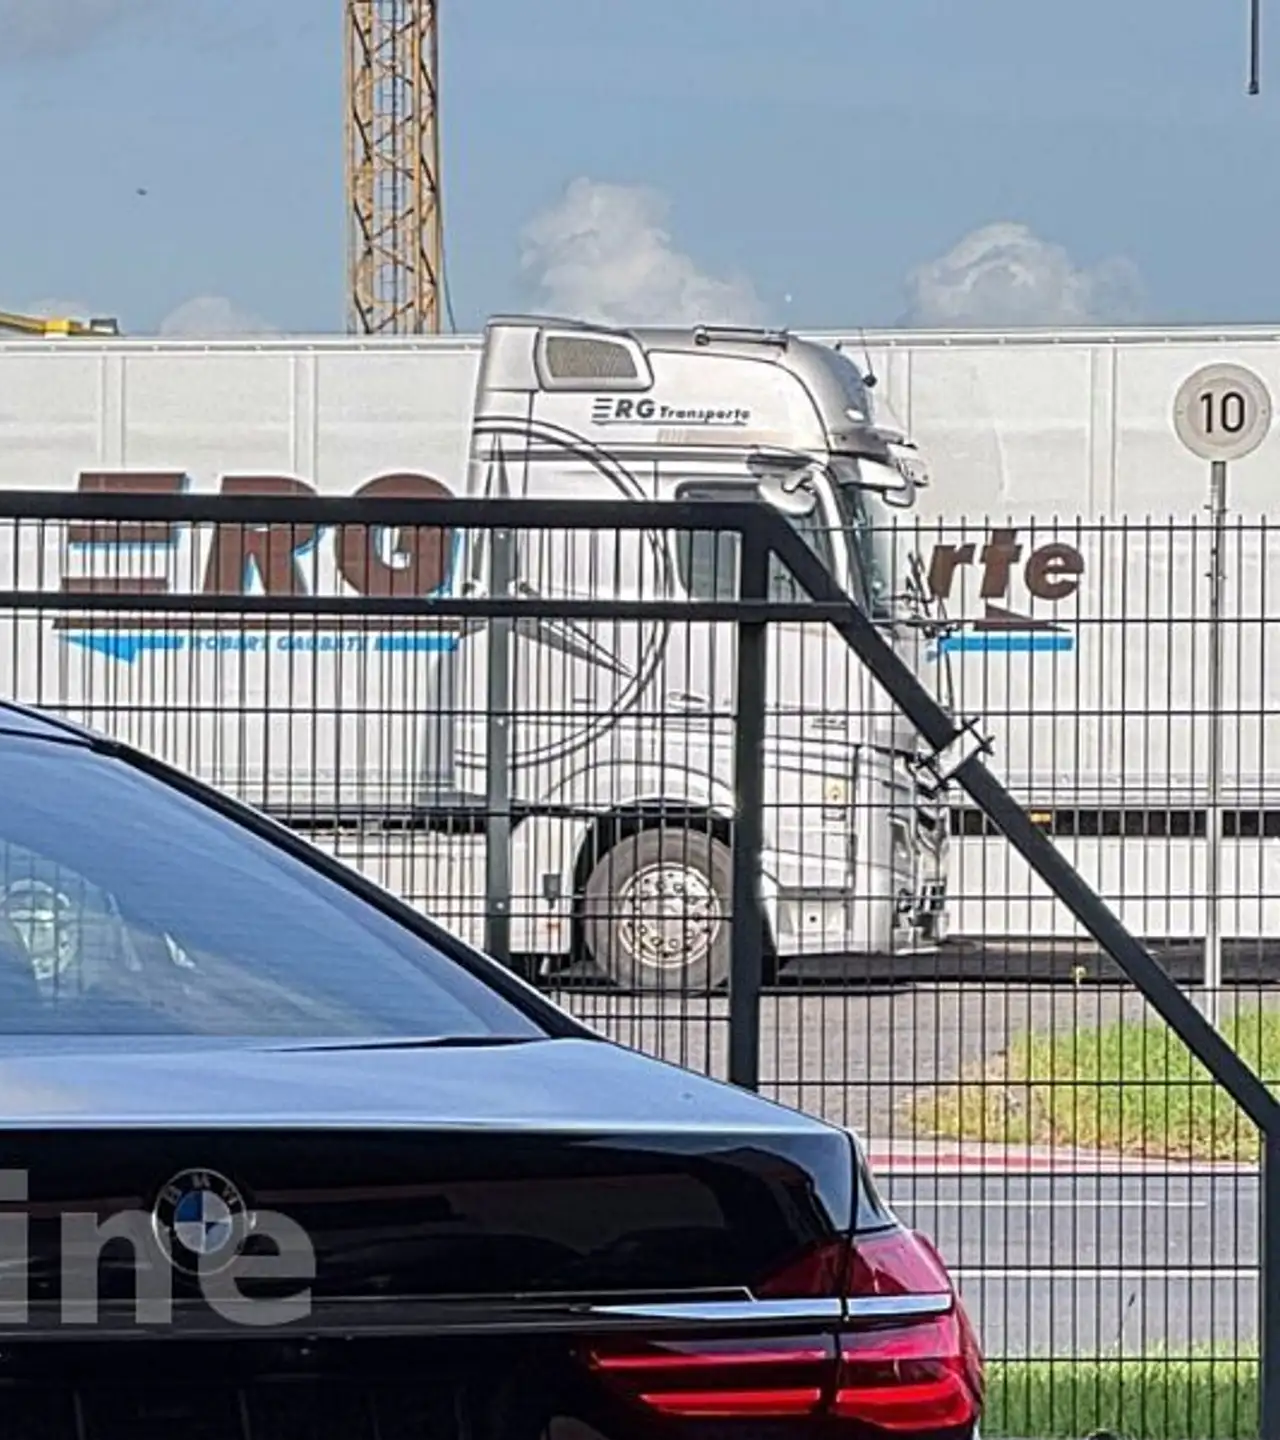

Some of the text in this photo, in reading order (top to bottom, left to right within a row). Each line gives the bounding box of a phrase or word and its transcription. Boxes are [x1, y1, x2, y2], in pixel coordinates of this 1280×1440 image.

[591, 397, 657, 420] ERG
[1200, 391, 1246, 434] 10
[61, 471, 464, 604] ERG
